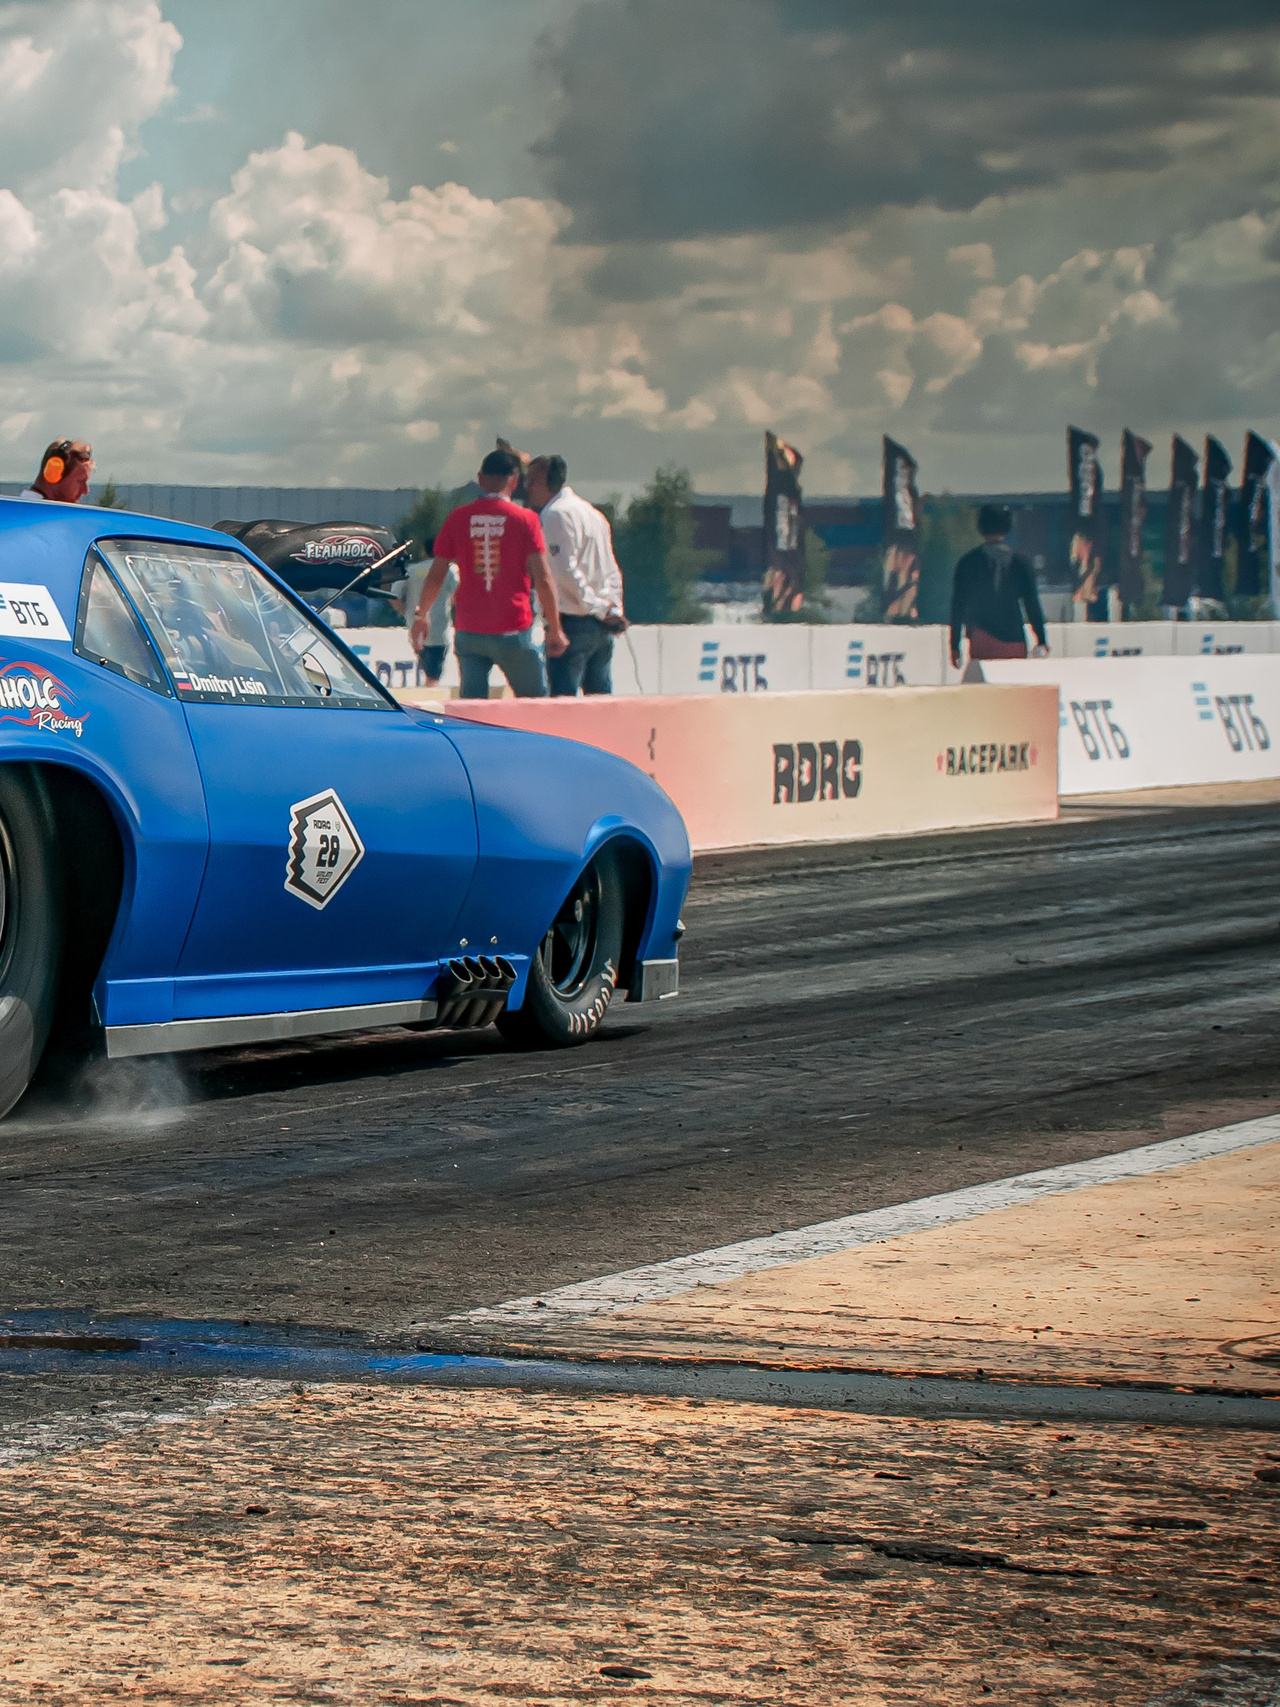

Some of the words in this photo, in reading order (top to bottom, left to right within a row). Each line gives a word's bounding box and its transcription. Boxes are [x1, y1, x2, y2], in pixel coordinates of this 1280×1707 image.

[9, 600, 49, 626] ВТБ
[189, 672, 236, 697] Dmitry
[233, 676, 267, 695] Lisin
[33, 711, 83, 737] Racing
[1070, 700, 1130, 760] ВТБ
[1215, 694, 1270, 751] ВТБ
[773, 739, 862, 804] RDRC
[946, 741, 1029, 775] RACEPARK
[316, 834, 340, 868] 28
